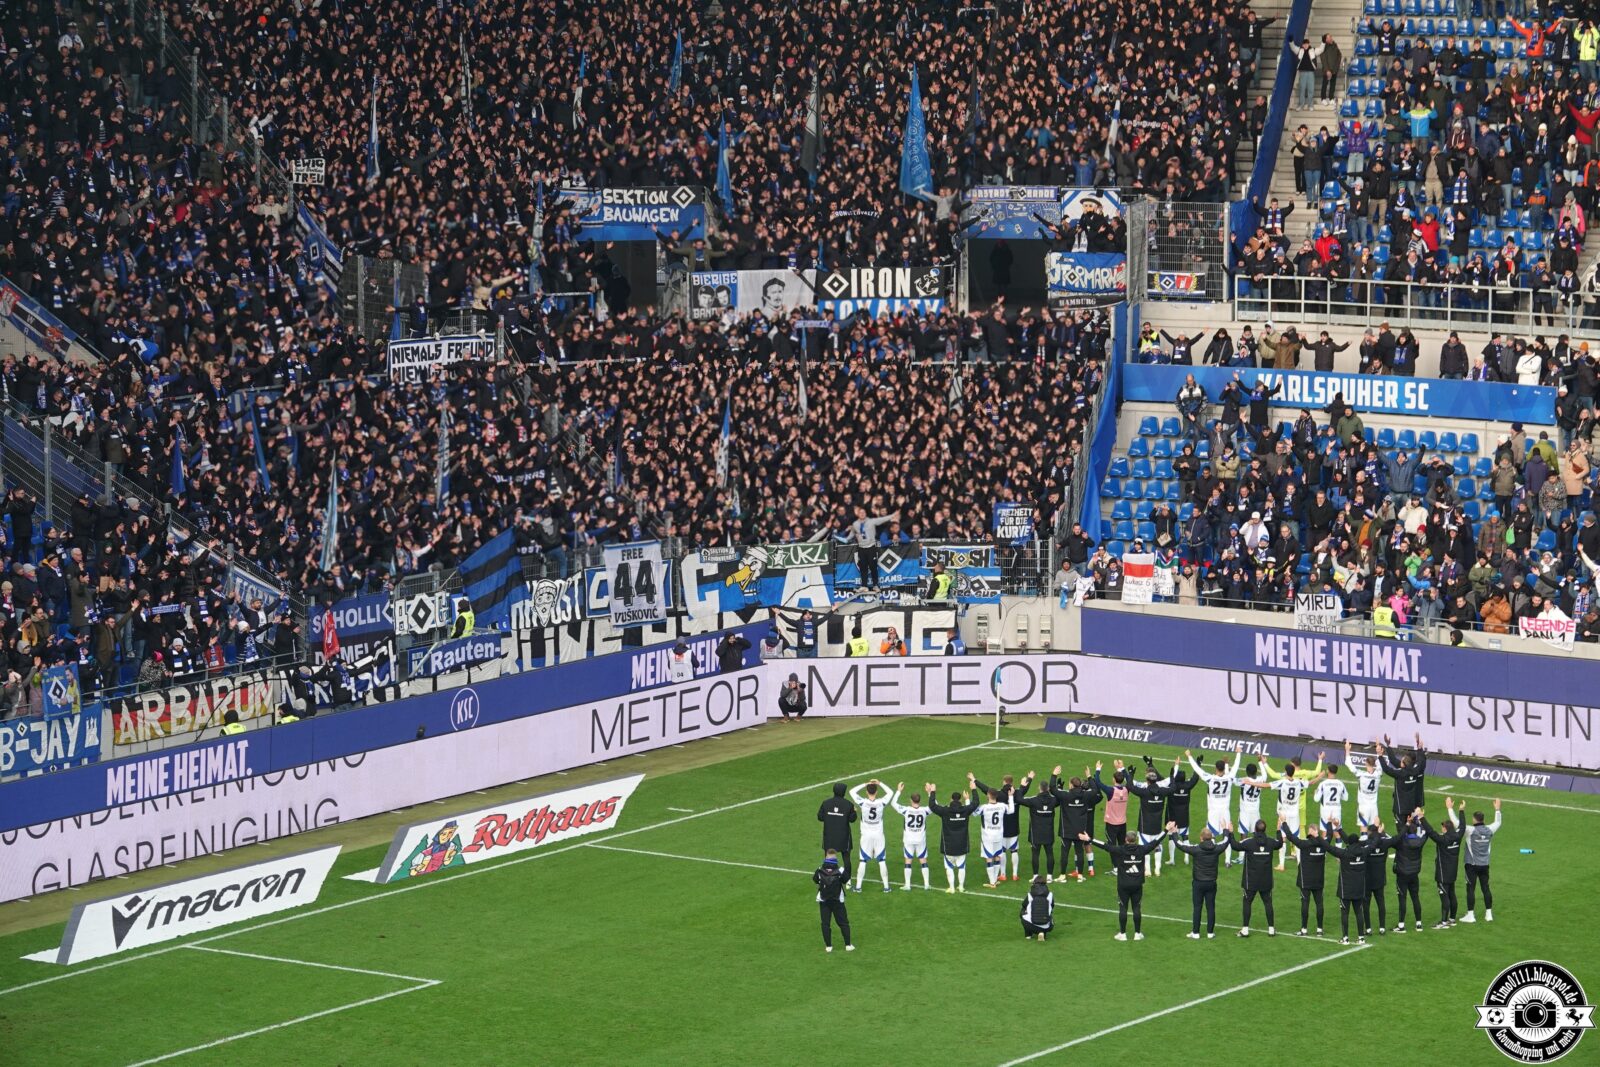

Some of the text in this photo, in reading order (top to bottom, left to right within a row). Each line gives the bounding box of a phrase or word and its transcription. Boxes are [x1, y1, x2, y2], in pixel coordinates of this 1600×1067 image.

[603, 206, 680, 223] BAUWAGEN
[692, 273, 738, 286] BIERIGE
[851, 267, 912, 298] IRON
[391, 343, 443, 365] NIEMALS
[1257, 373, 1429, 411] KARLSRUHER SC
[997, 508, 1033, 516] FREIHEIT
[1000, 515, 1028, 525] FÜR DIE
[996, 525, 1032, 538] KURVE
[621, 547, 644, 561] FREE
[613, 560, 657, 606] 44
[1295, 594, 1336, 611] MIRO
[614, 606, 660, 623] VUŠKOVIĆ
[1520, 617, 1576, 632] LEGENDE
[1525, 630, 1554, 640] DANI
[431, 640, 501, 675] Rauten-
[1254, 632, 1428, 685] MEINE HEIMAT.
[631, 647, 671, 690] MEIN
[807, 660, 1080, 708] METEOR
[457, 696, 474, 724] KSC
[591, 673, 760, 755] METEOR
[1078, 723, 1153, 743] CRONIMET
[1200, 736, 1271, 756] CREMETAL
[106, 739, 253, 807] MEINE HEIMAT.
[1469, 767, 1551, 787] CRONIMET
[1212, 781, 1229, 795] 27
[1246, 785, 1260, 798] 45
[1287, 787, 1296, 800] 8
[1329, 787, 1338, 801] 2
[1367, 779, 1376, 792] 4
[868, 807, 877, 821] 5
[907, 814, 924, 829] 29
[991, 811, 1000, 825] 6
[461, 796, 622, 854] Rothaus
[147, 867, 306, 931] macron
